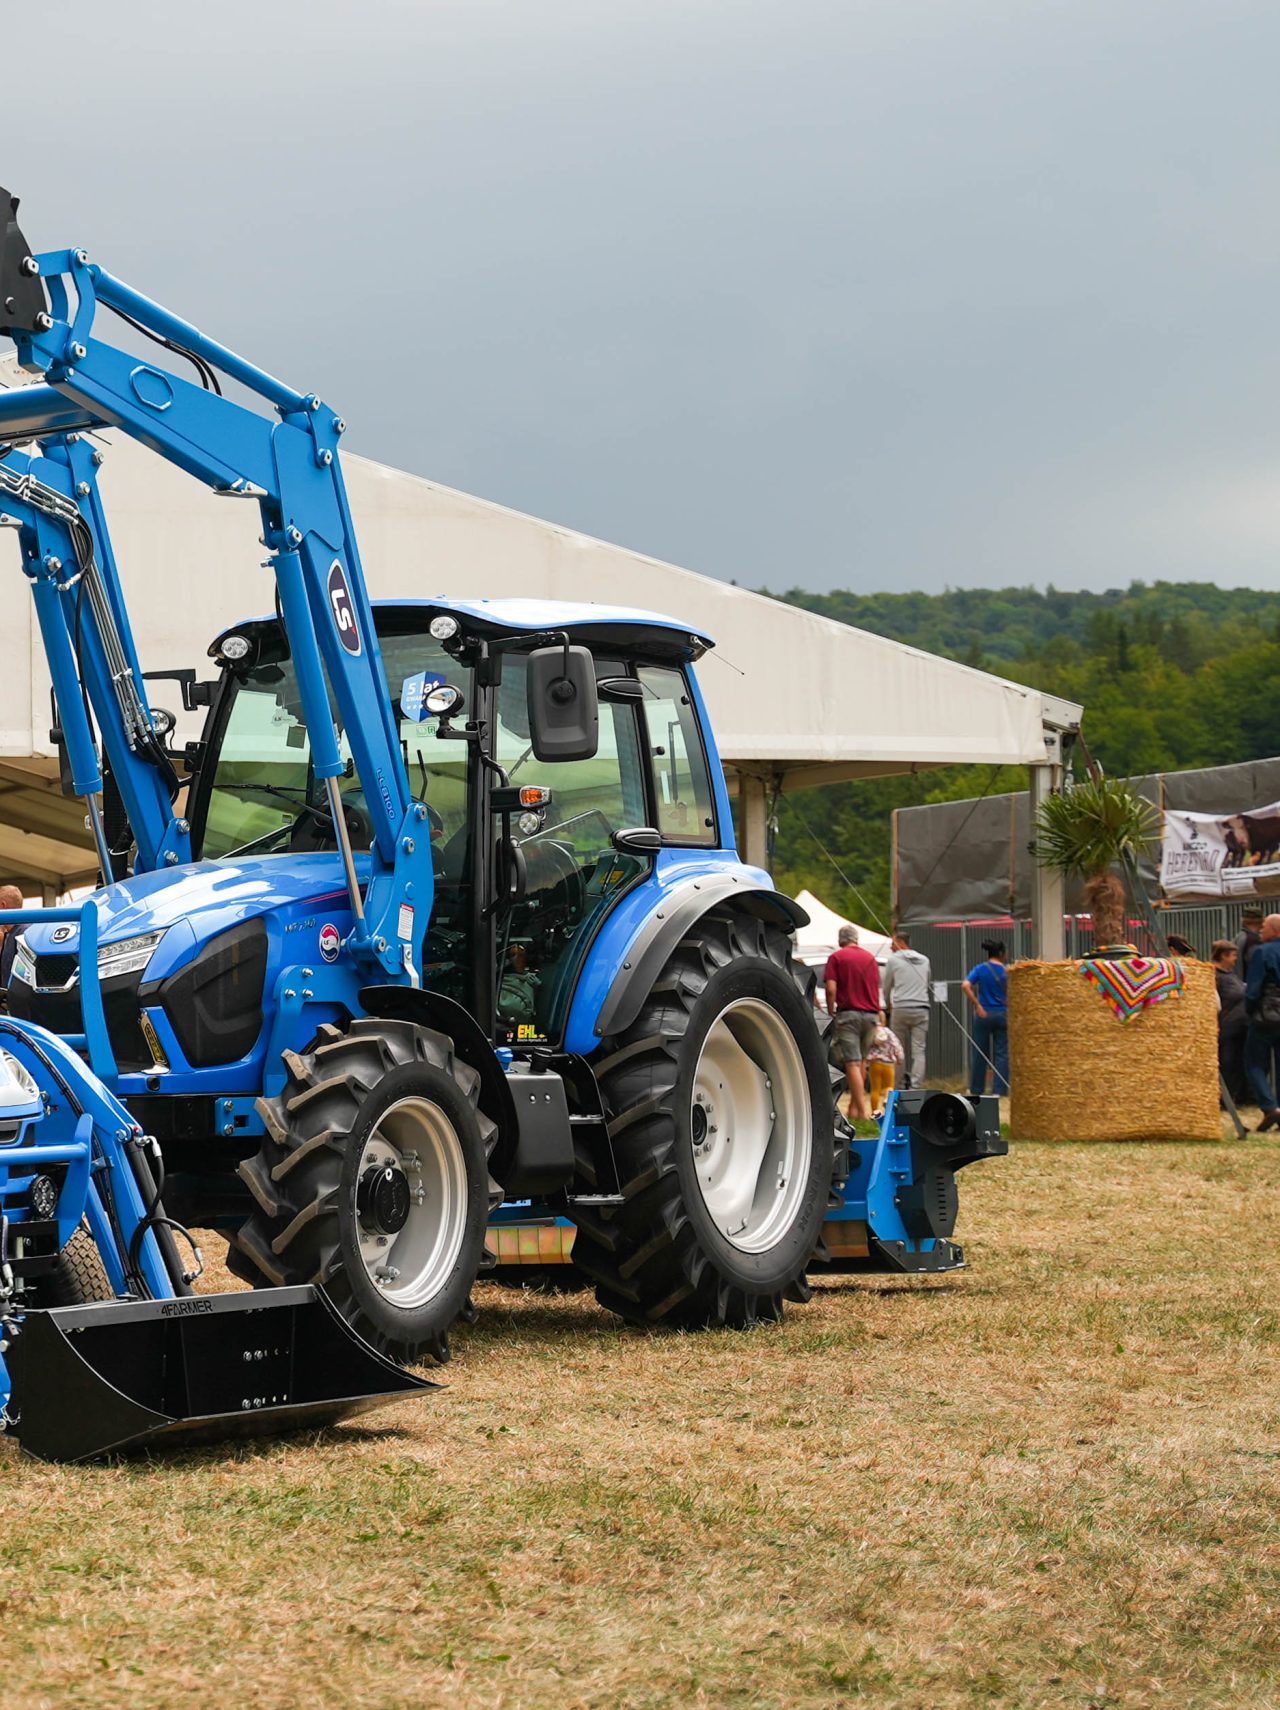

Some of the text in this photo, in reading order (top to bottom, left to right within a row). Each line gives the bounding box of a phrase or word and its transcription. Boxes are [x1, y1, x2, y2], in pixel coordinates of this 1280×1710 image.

[331, 588, 353, 631] LS
[407, 680, 439, 695] 5 lat
[517, 1024, 538, 1039] EHL
[161, 1300, 213, 1316] 4FARMER
